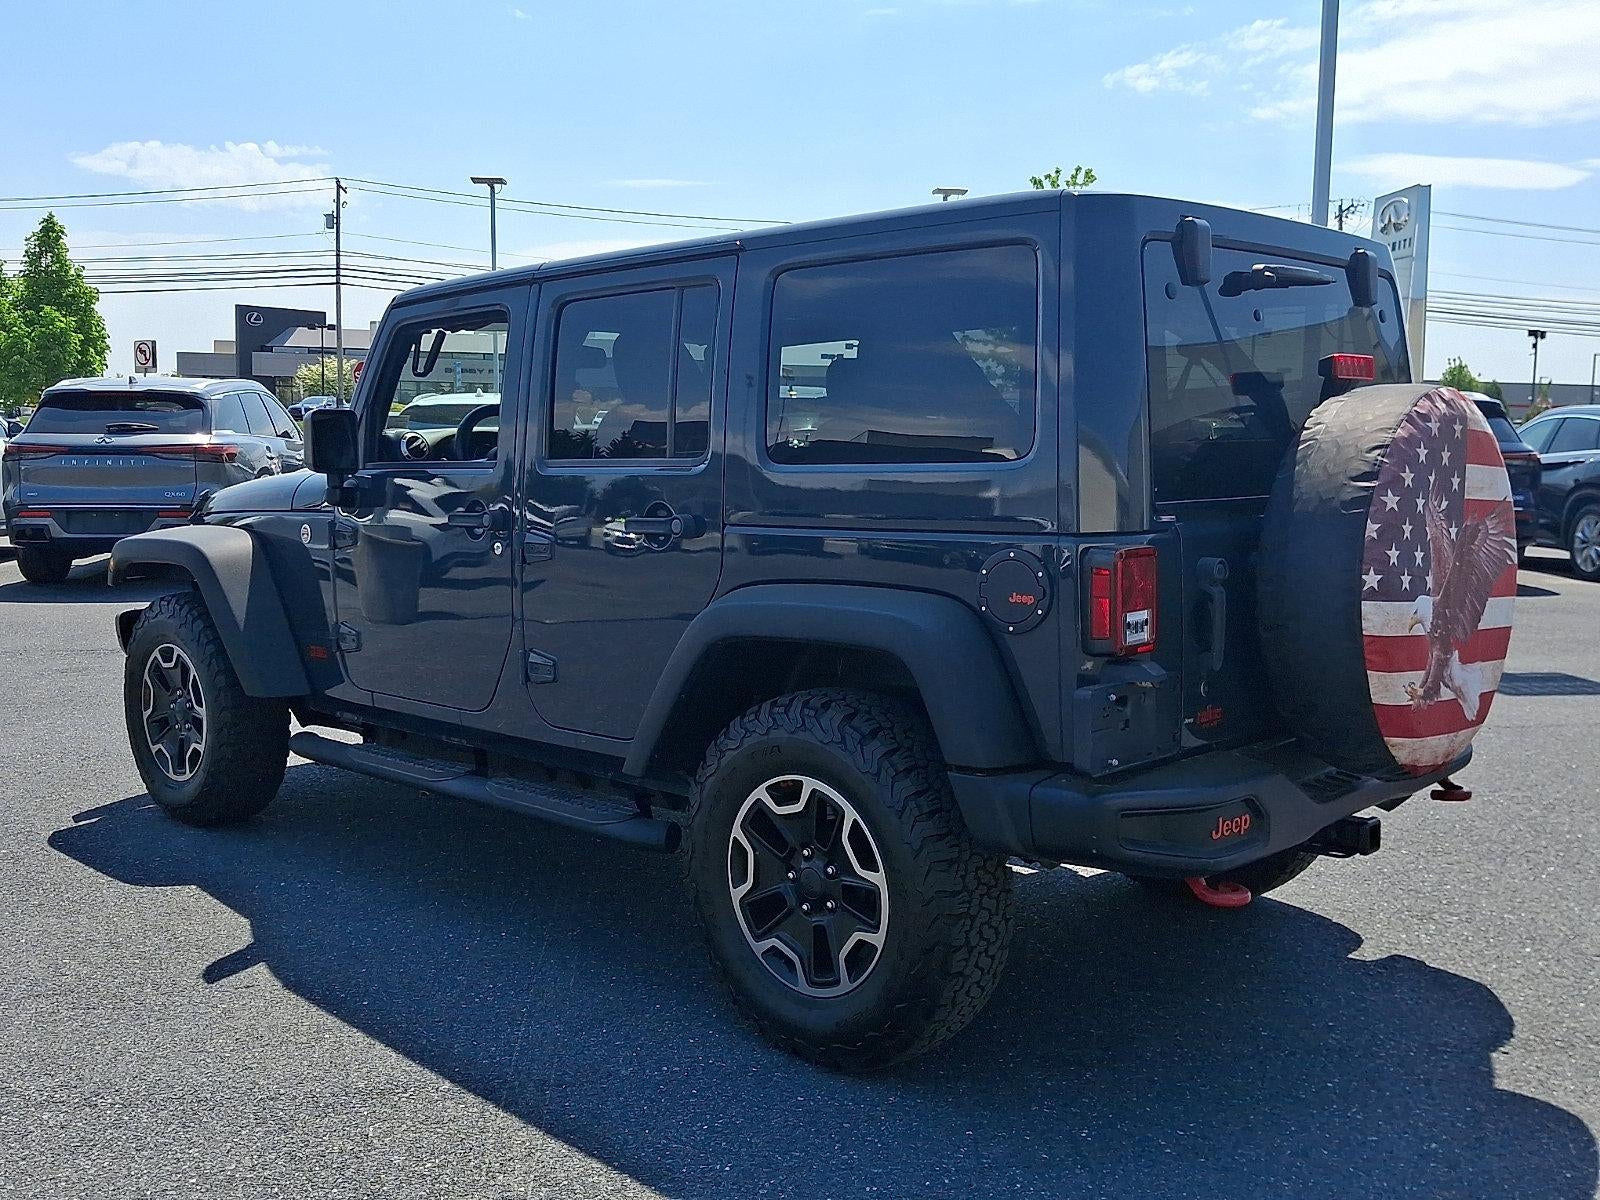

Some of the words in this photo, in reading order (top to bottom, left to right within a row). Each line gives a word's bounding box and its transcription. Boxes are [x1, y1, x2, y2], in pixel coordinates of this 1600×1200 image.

[1387, 237, 1412, 252] NITI
[444, 367, 485, 375] BBBY
[1008, 592, 1035, 606] Jeep
[1211, 814, 1251, 840] Jeep
